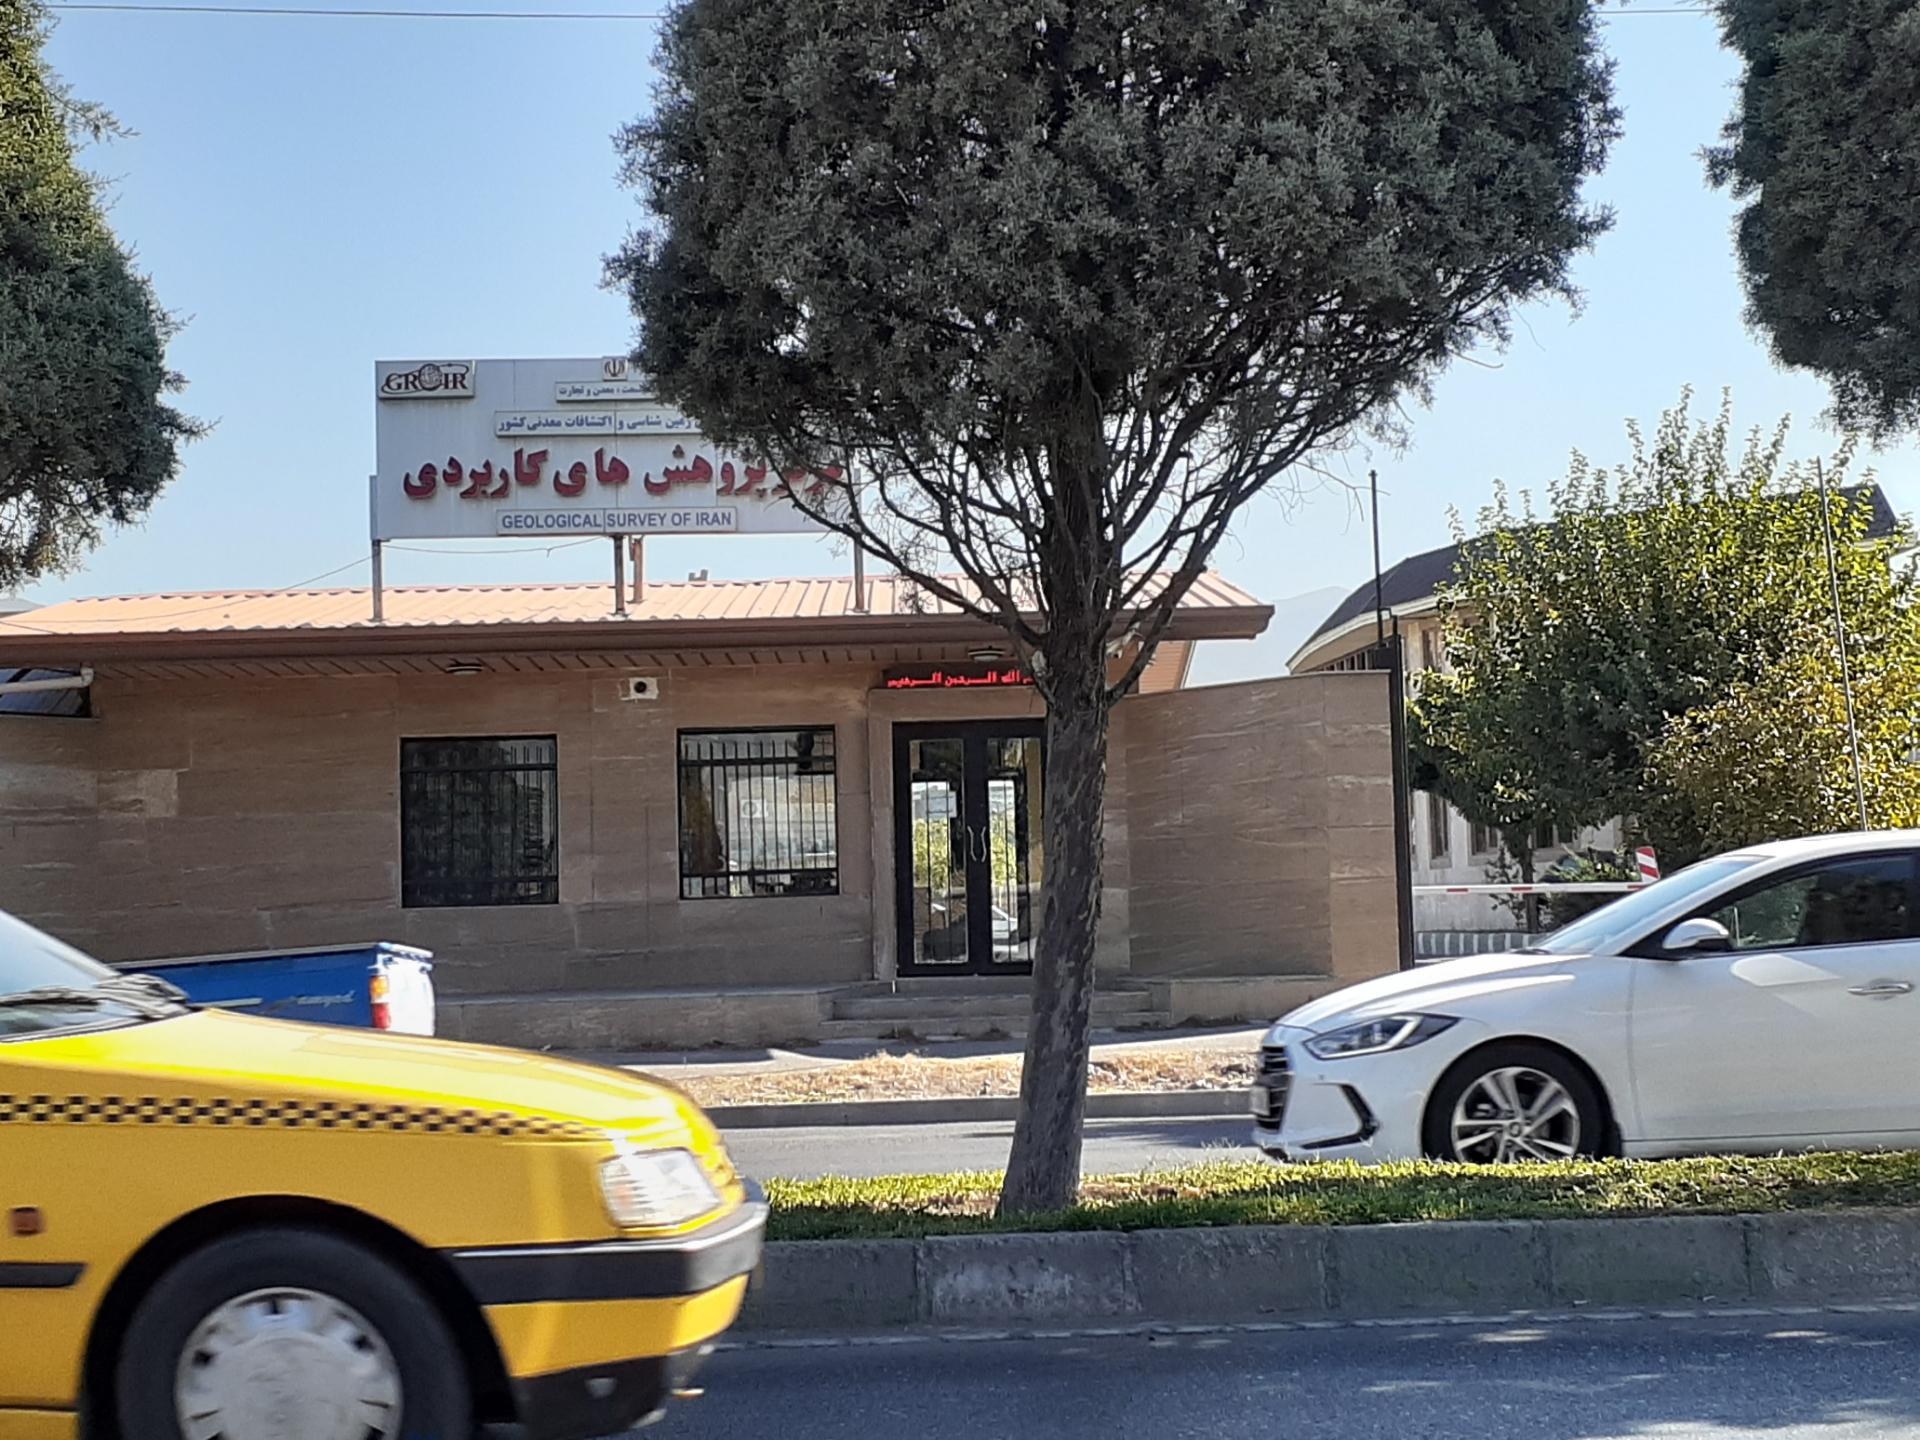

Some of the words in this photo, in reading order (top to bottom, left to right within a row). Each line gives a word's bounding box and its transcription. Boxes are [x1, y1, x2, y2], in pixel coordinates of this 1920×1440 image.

[558, 386, 584, 397] تجارت
[498, 416, 527, 432] کشور
[527, 416, 562, 432] معدنی
[564, 415, 612, 429] اکتشافات
[626, 414, 662, 430] شناسی
[403, 447, 549, 500] کاربردی
[553, 447, 630, 498] های
[502, 513, 603, 529] GEOLOGICAL
[607, 512, 667, 528] SURVEY
[671, 511, 690, 526] OF
[695, 511, 732, 526] IRAN
